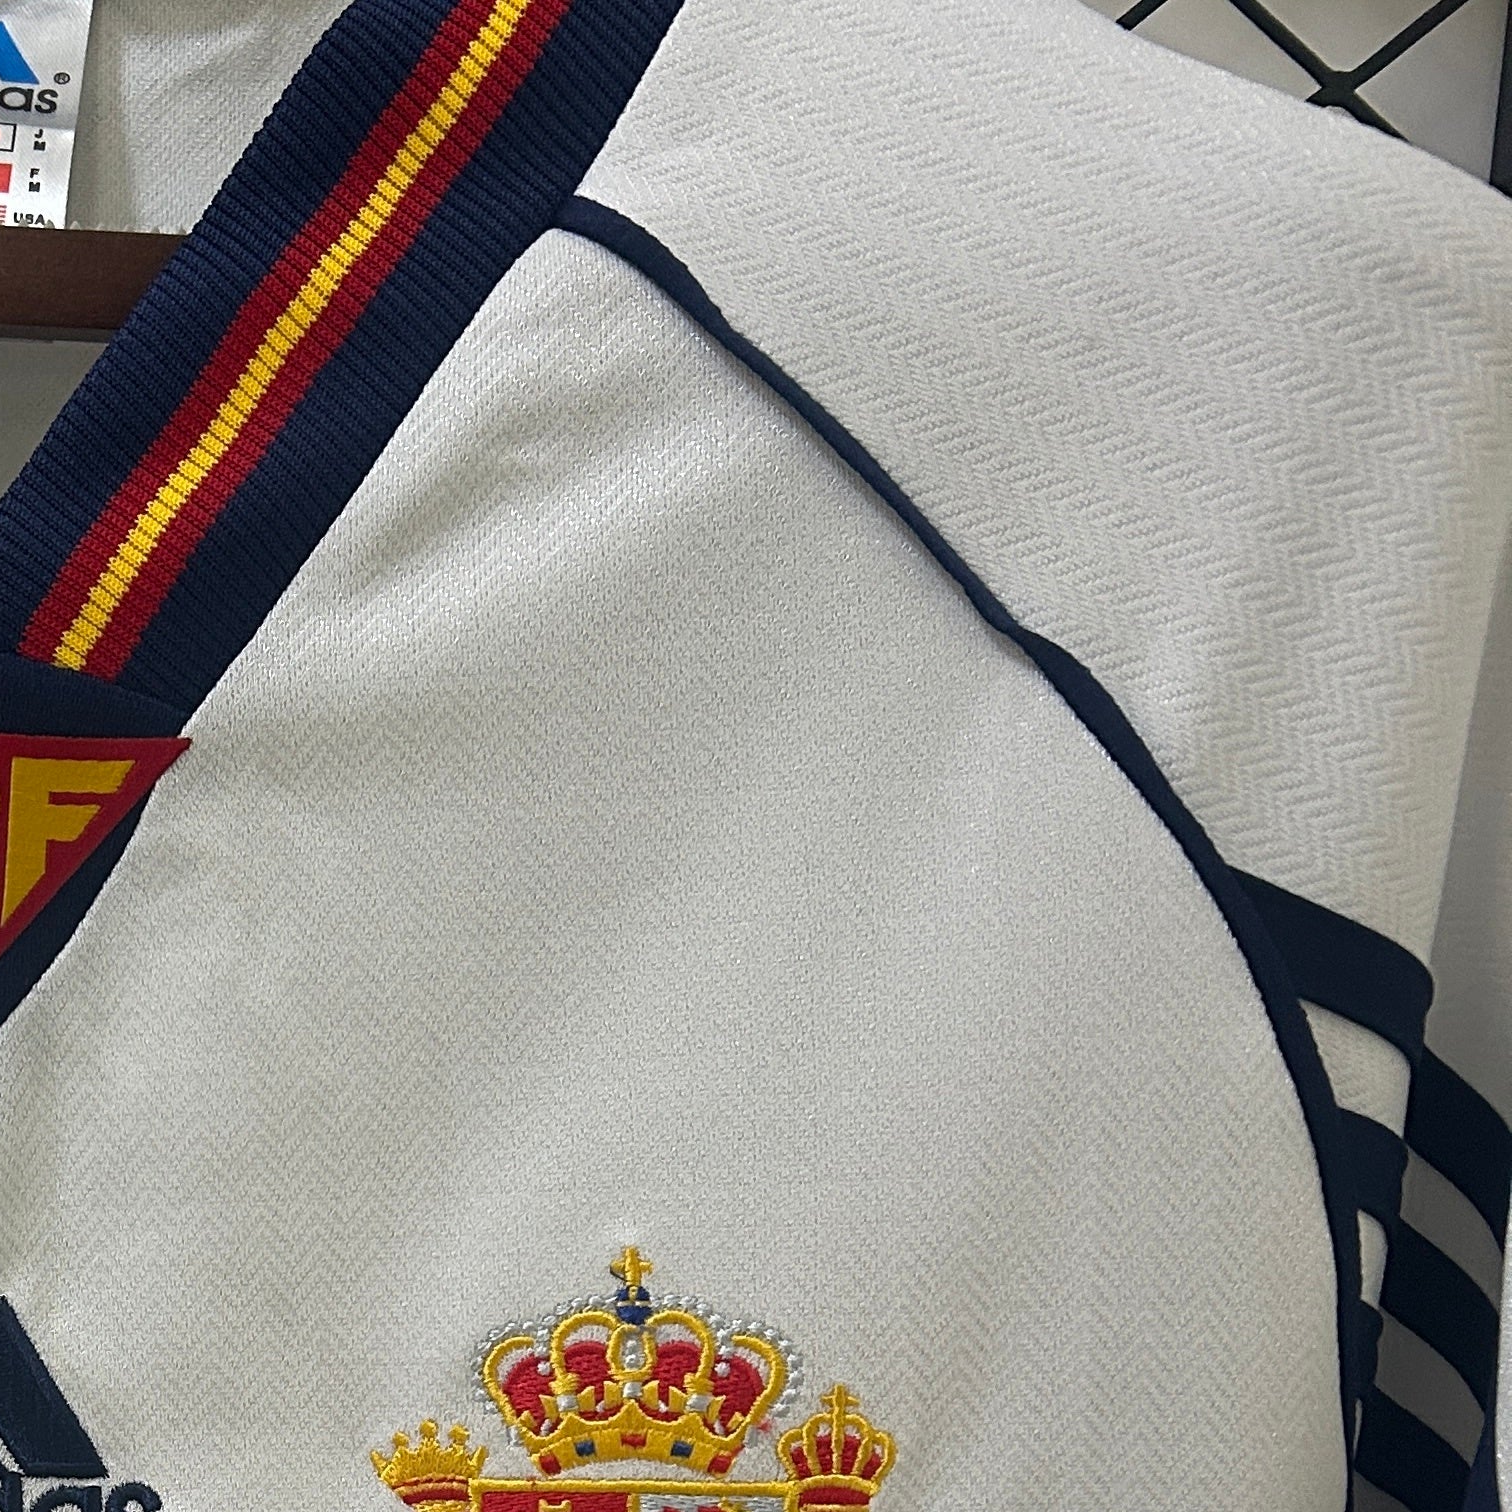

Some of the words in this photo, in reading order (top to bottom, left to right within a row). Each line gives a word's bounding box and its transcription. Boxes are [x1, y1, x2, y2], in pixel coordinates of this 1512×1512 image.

[34, 129, 44, 139] J
[33, 140, 46, 152] M
[29, 168, 40, 179] F
[28, 181, 41, 193] M
[13, 211, 45, 225] USA
